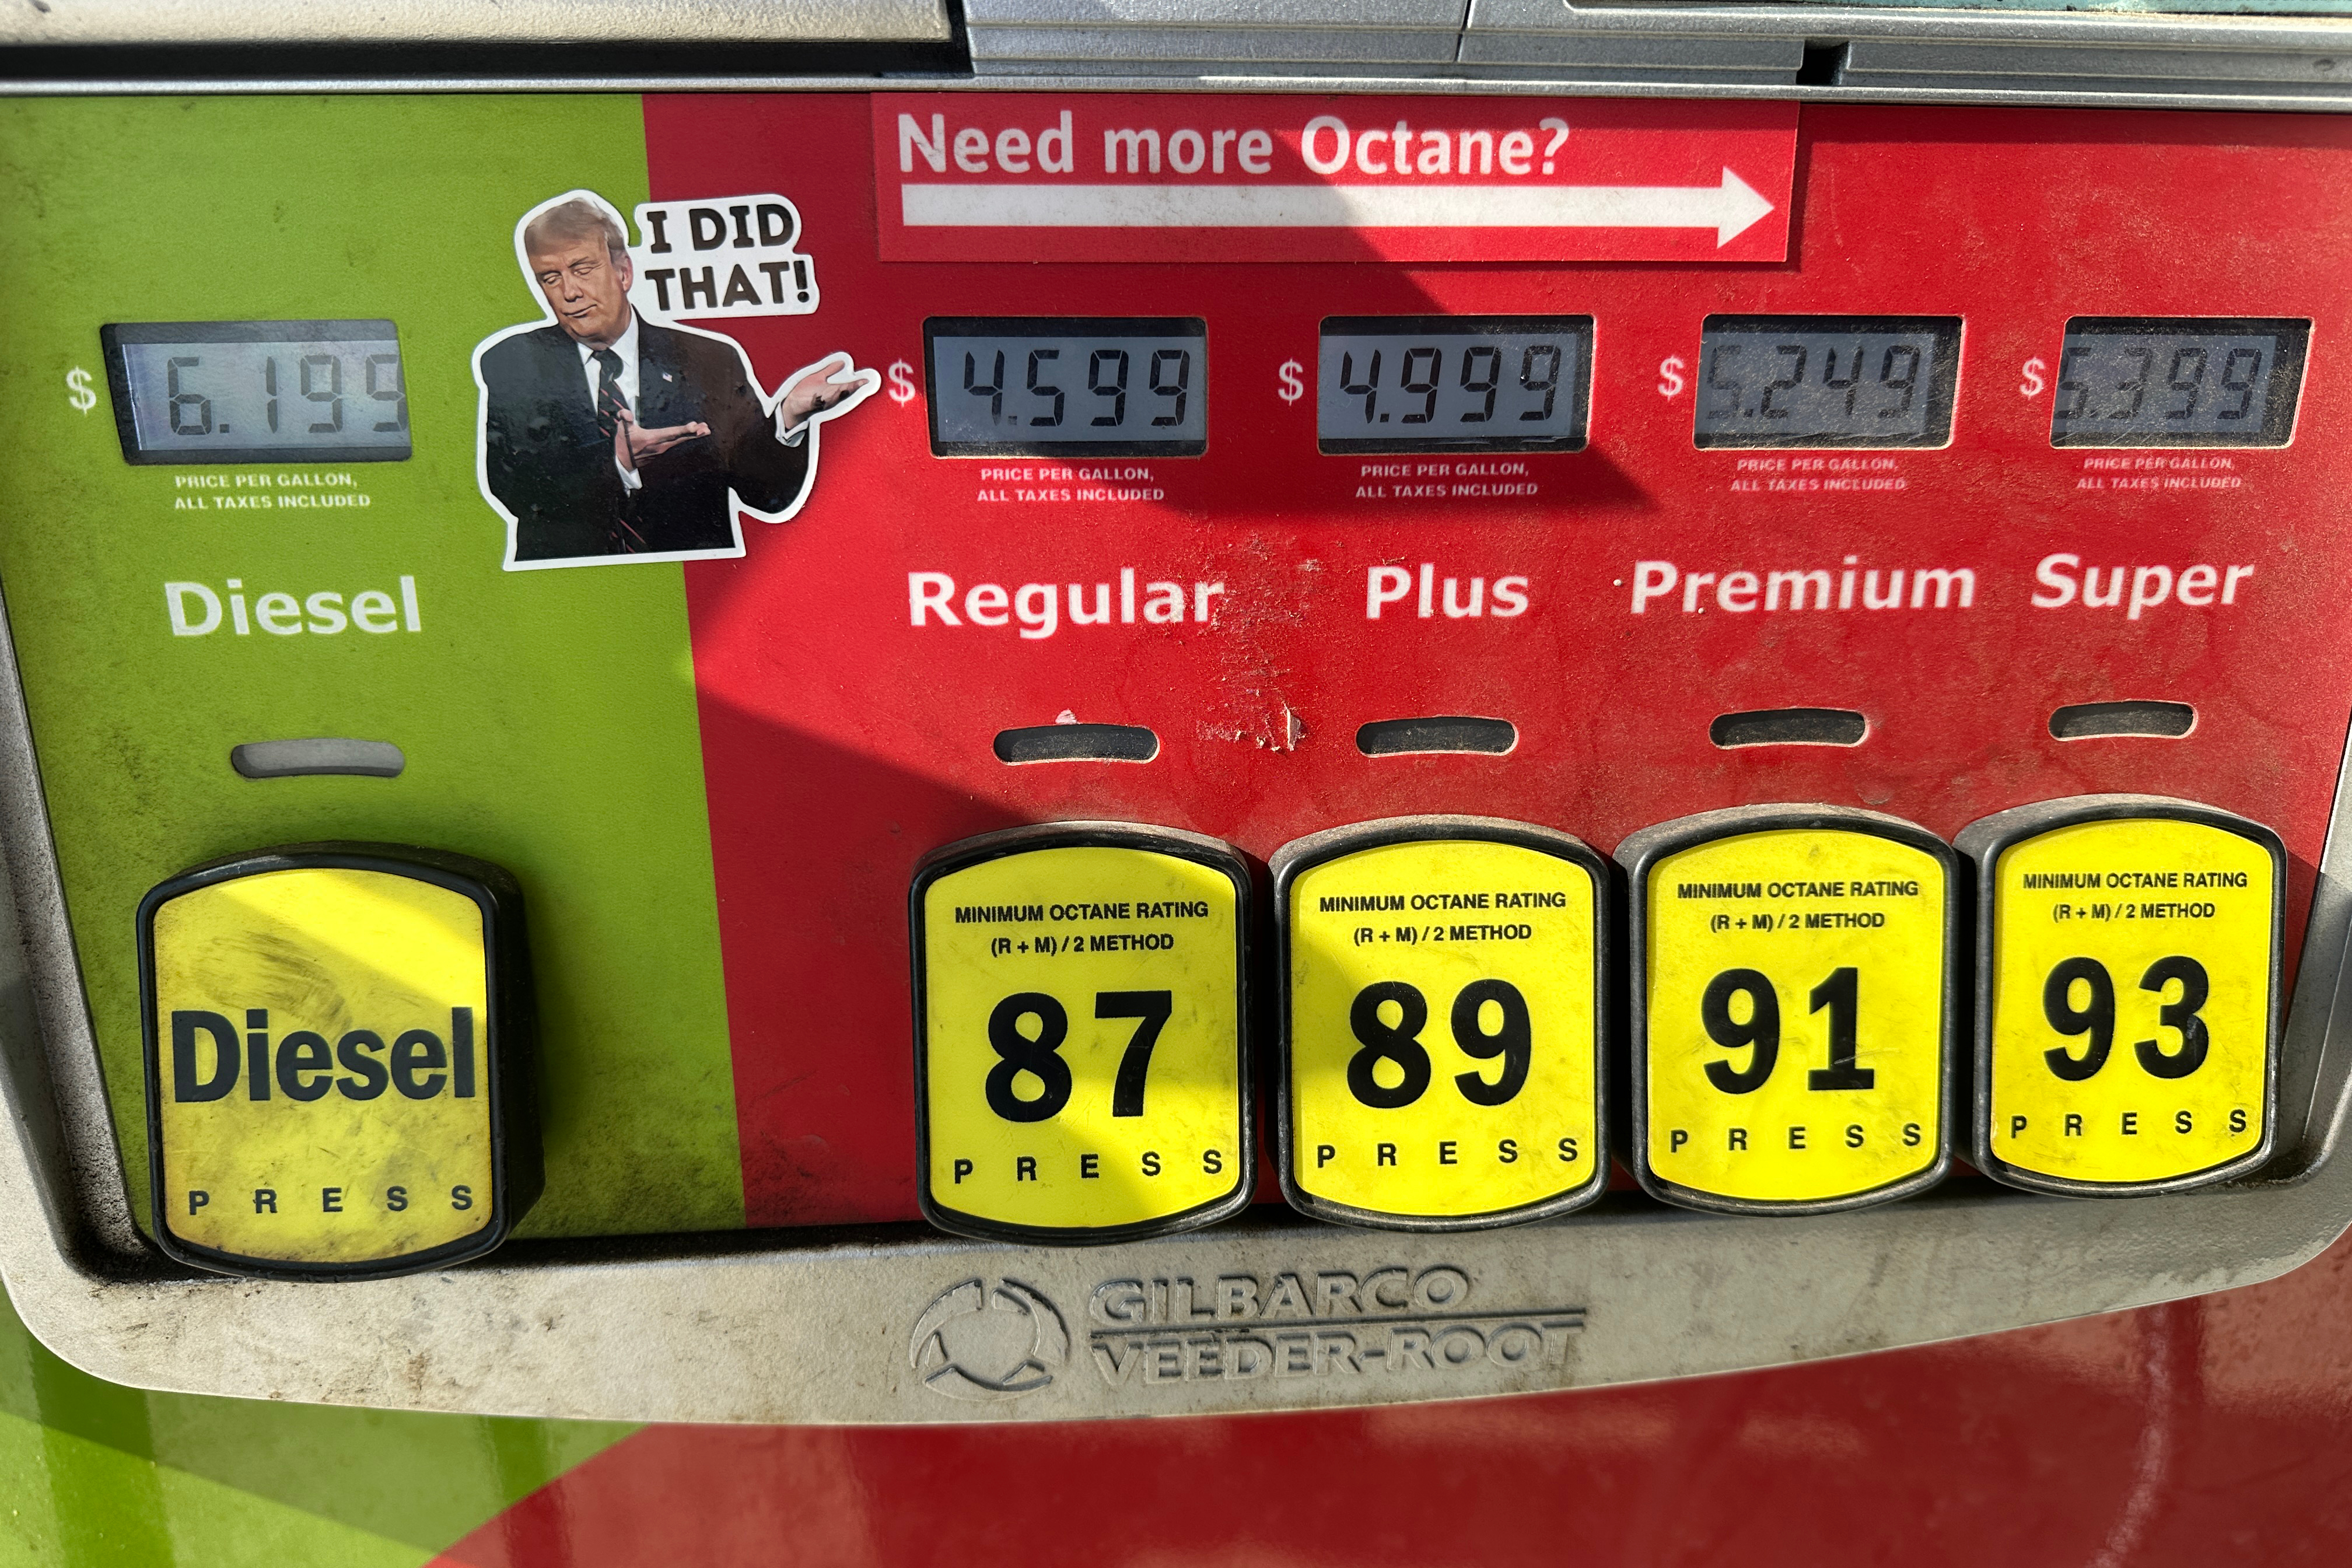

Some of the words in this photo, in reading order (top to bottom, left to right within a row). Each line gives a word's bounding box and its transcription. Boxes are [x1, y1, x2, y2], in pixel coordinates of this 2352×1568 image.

[898, 110, 1074, 174] Need
[1104, 128, 1272, 174] more
[1301, 115, 1569, 176] Octane?
[647, 211, 672, 254] I
[689, 204, 794, 251] DID
[645, 260, 810, 311] THAT!
[167, 354, 406, 435] 6.199
[1340, 345, 1562, 424] 4.999
[175, 474, 230, 488] PRICE
[236, 473, 272, 487] PER
[977, 489, 1009, 502] ALL
[1015, 489, 1070, 501] TAXES
[1076, 488, 1164, 501] INCLUDED
[981, 467, 1033, 480] PRICE
[1039, 467, 1073, 480] PER
[1356, 485, 1386, 497] ALL
[1394, 485, 1447, 497] TAXES
[1452, 483, 1538, 496] INCLUDED
[1361, 464, 1411, 477] PRICE
[1416, 463, 1450, 476] PER
[175, 496, 208, 509] ALL
[214, 496, 272, 509] TAXES
[278, 494, 370, 508] INCLUDED
[164, 576, 421, 636] Diesel
[908, 568, 1224, 639] Regular
[1366, 562, 1530, 620] Plus
[1630, 555, 1976, 615] Premium
[2031, 552, 2255, 620] Super
[1320, 894, 1405, 912] MINIMUM
[1410, 893, 1489, 909] OCTANE
[1495, 892, 1566, 908] RATING
[1678, 883, 1760, 899] MINIMUM
[1767, 882, 1845, 897] OCTANE
[1850, 881, 1919, 897] RATING
[2023, 873, 2100, 889] MINIMUM
[2106, 873, 2177, 888] OCTANE
[2183, 872, 2248, 888] RATING
[955, 904, 1044, 923] MINIMUM
[1049, 902, 1130, 921] OCTANE
[1136, 901, 1208, 919] RATING
[1450, 925, 1531, 942] METHOD
[1805, 912, 1885, 929] METHOD
[2140, 903, 2215, 919] METHOD
[1090, 933, 1174, 951] METHOD
[1347, 979, 1531, 1109] 89
[1701, 967, 1875, 1094] 91
[2043, 956, 2209, 1081] 93
[172, 1006, 475, 1102] Diesel
[985, 990, 1172, 1123] 87
[1089, 1264, 1468, 1325] GILBARCO
[1092, 1320, 1584, 1385] VEEDER-ROOT
